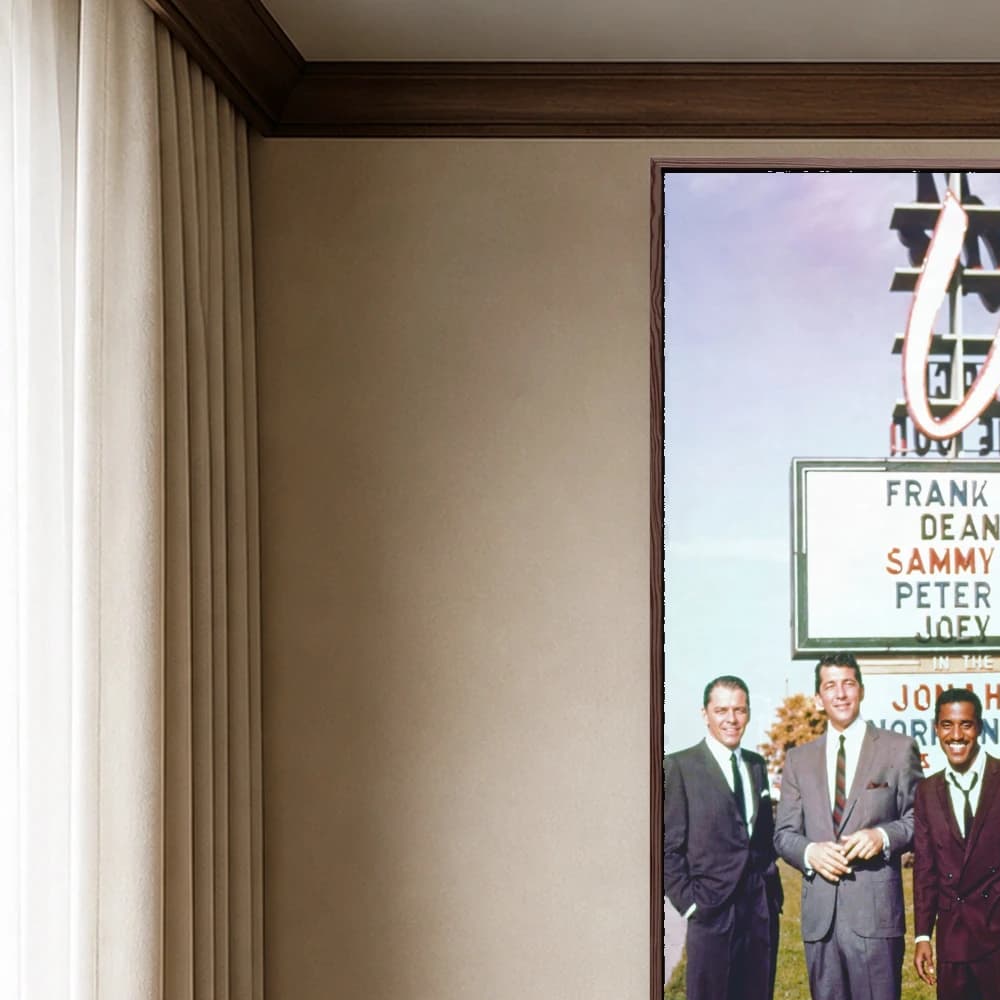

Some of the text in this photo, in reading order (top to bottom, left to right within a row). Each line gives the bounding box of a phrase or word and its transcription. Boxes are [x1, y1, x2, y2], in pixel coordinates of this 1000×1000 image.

[886, 479, 988, 507] FRANK
[920, 513, 1000, 541] DEAN
[886, 547, 995, 575] SAMMY
[896, 581, 992, 608] PETER
[915, 614, 991, 643] JOEY
[932, 656, 949, 669] IN
[962, 655, 993, 669] THE
